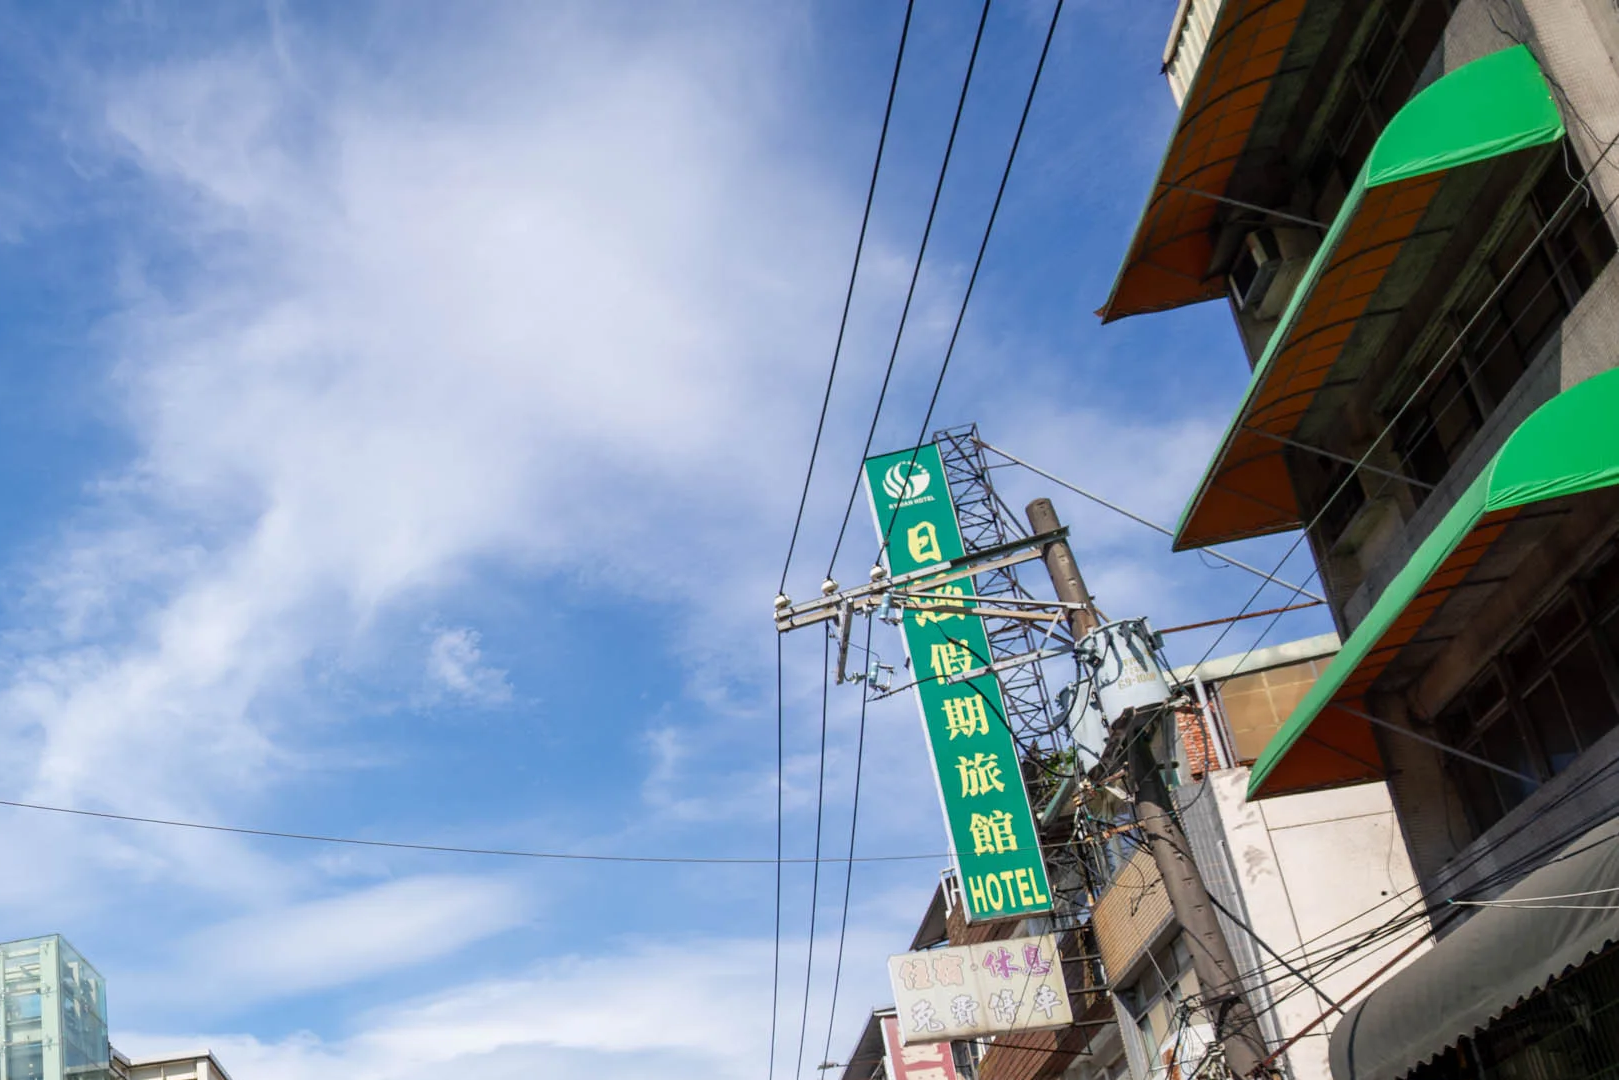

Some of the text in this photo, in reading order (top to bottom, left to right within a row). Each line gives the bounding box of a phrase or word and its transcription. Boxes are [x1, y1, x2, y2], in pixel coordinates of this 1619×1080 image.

[969, 867, 1047, 914] HOTEL
[899, 944, 1054, 991] 住宿 休息
[911, 984, 1063, 1033] 免費停車
